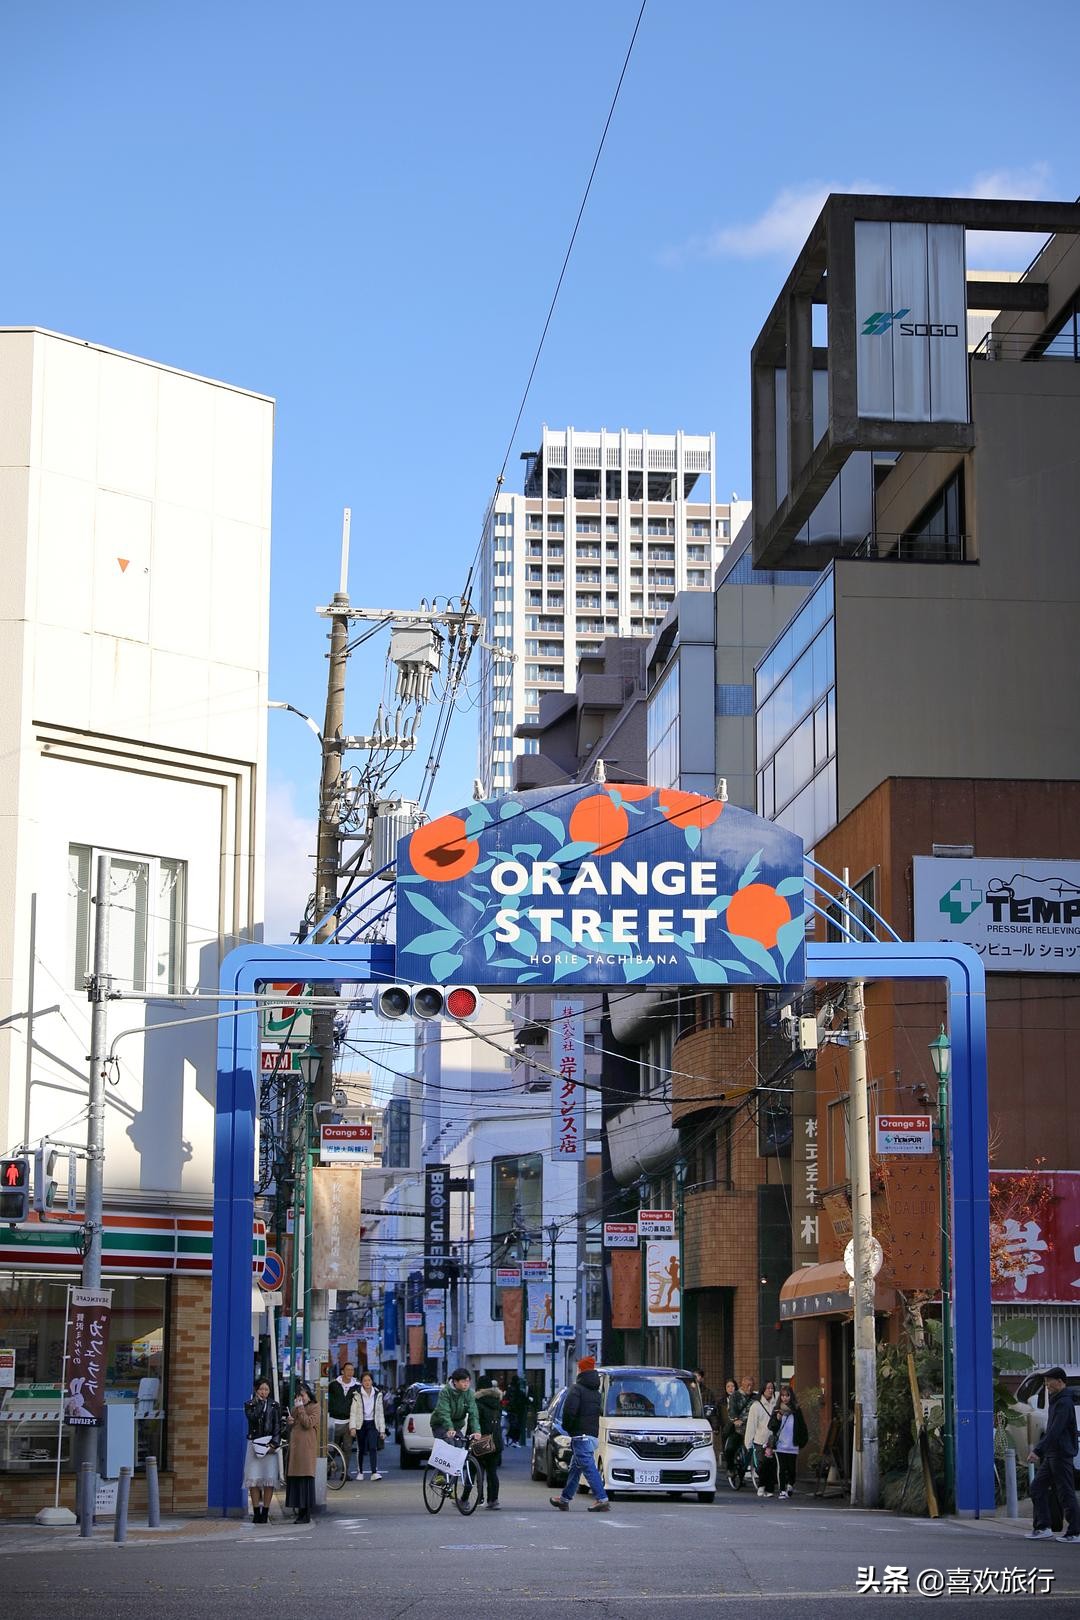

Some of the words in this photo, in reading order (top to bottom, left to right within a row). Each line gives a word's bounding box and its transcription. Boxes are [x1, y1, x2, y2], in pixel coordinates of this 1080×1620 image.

[900, 323, 958, 337] SOGO
[490, 861, 717, 896] ORANGE
[495, 908, 718, 944] STREET
[987, 925, 1033, 934] PRESSURE
[1036, 926, 1080, 935] RELIEVING
[530, 955, 578, 965] HORIE
[586, 955, 678, 965] TACHIBANA
[562, 1005, 575, 1051] 株式会社
[264, 1053, 288, 1069] ATM
[559, 1056, 577, 1153] 岸タンス店
[881, 1120, 914, 1129] Orange
[324, 1128, 357, 1138] Orange
[359, 1128, 370, 1136] St.
[434, 1456, 451, 1468] SORA
